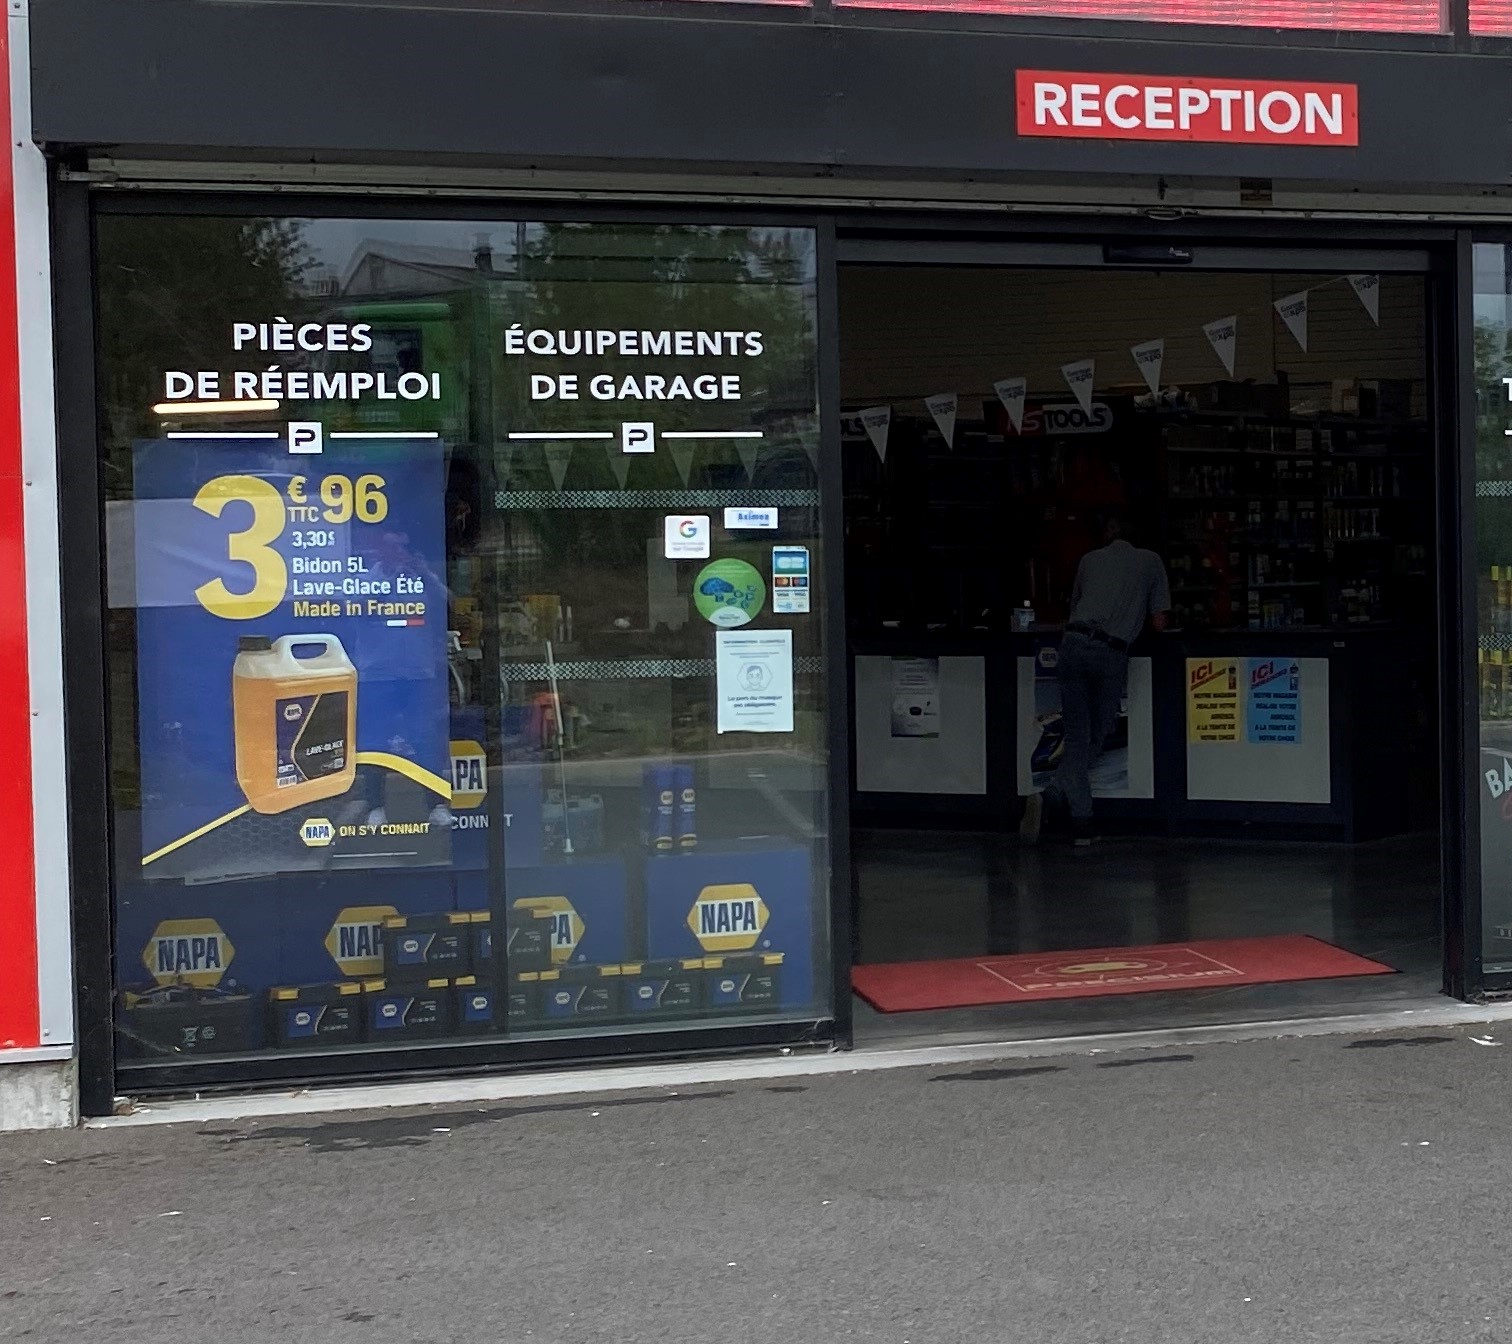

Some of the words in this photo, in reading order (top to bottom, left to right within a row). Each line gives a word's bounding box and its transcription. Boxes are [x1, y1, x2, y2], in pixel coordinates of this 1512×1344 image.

[1033, 82, 1344, 135] RECEPTION
[233, 317, 373, 351] PIÈCES
[504, 323, 764, 356] ÉQUIPEMENTS
[165, 372, 219, 399] DE
[234, 365, 441, 400] RÉEMPLOI
[531, 375, 579, 400] DE
[590, 374, 742, 400] GARAGE
[1043, 408, 1107, 429] TOOLS
[287, 506, 320, 522] TTC
[192, 475, 288, 620] 3
[321, 474, 388, 523] 96
[292, 557, 342, 574] Bidon
[347, 557, 369, 573] 5L
[293, 578, 391, 596] Lave-Glace
[396, 574, 424, 594] Été
[293, 601, 341, 617] Made
[346, 600, 362, 616] in
[367, 600, 426, 615] France
[1191, 661, 1213, 683] ICI
[1251, 661, 1274, 683] ICI
[306, 827, 330, 839] NAPA
[339, 826, 356, 837] ON
[359, 825, 378, 835] S'Y
[381, 823, 430, 835] CONNAIT
[702, 901, 758, 934] NAPA
[340, 924, 384, 958] NAP
[158, 937, 221, 972] NAPA
